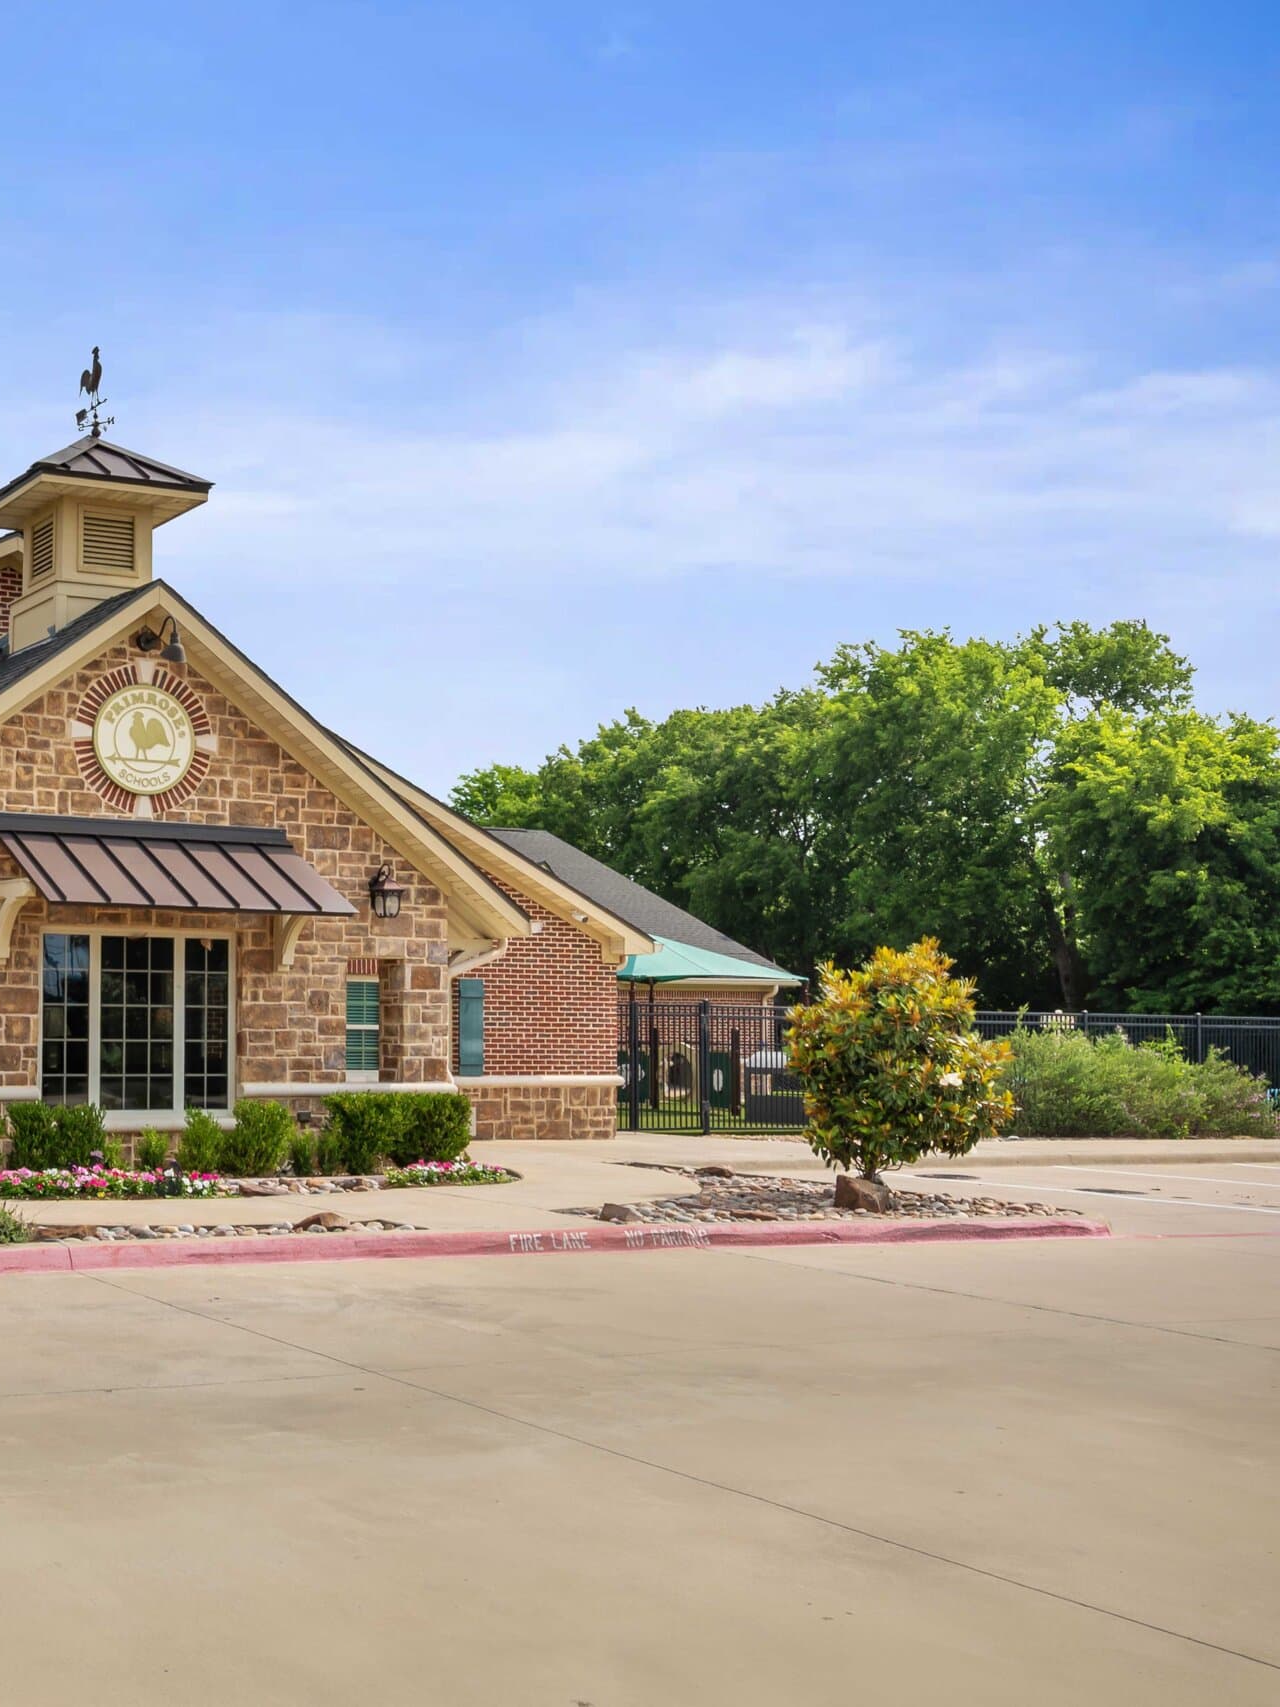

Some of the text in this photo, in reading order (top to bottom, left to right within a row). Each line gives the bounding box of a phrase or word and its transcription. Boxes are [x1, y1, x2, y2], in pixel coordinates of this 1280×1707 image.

[103, 692, 186, 730] PRIMROSE
[118, 769, 171, 788] SCHOOLS
[509, 1228, 711, 1251] FIRE LANE NO PARKING
